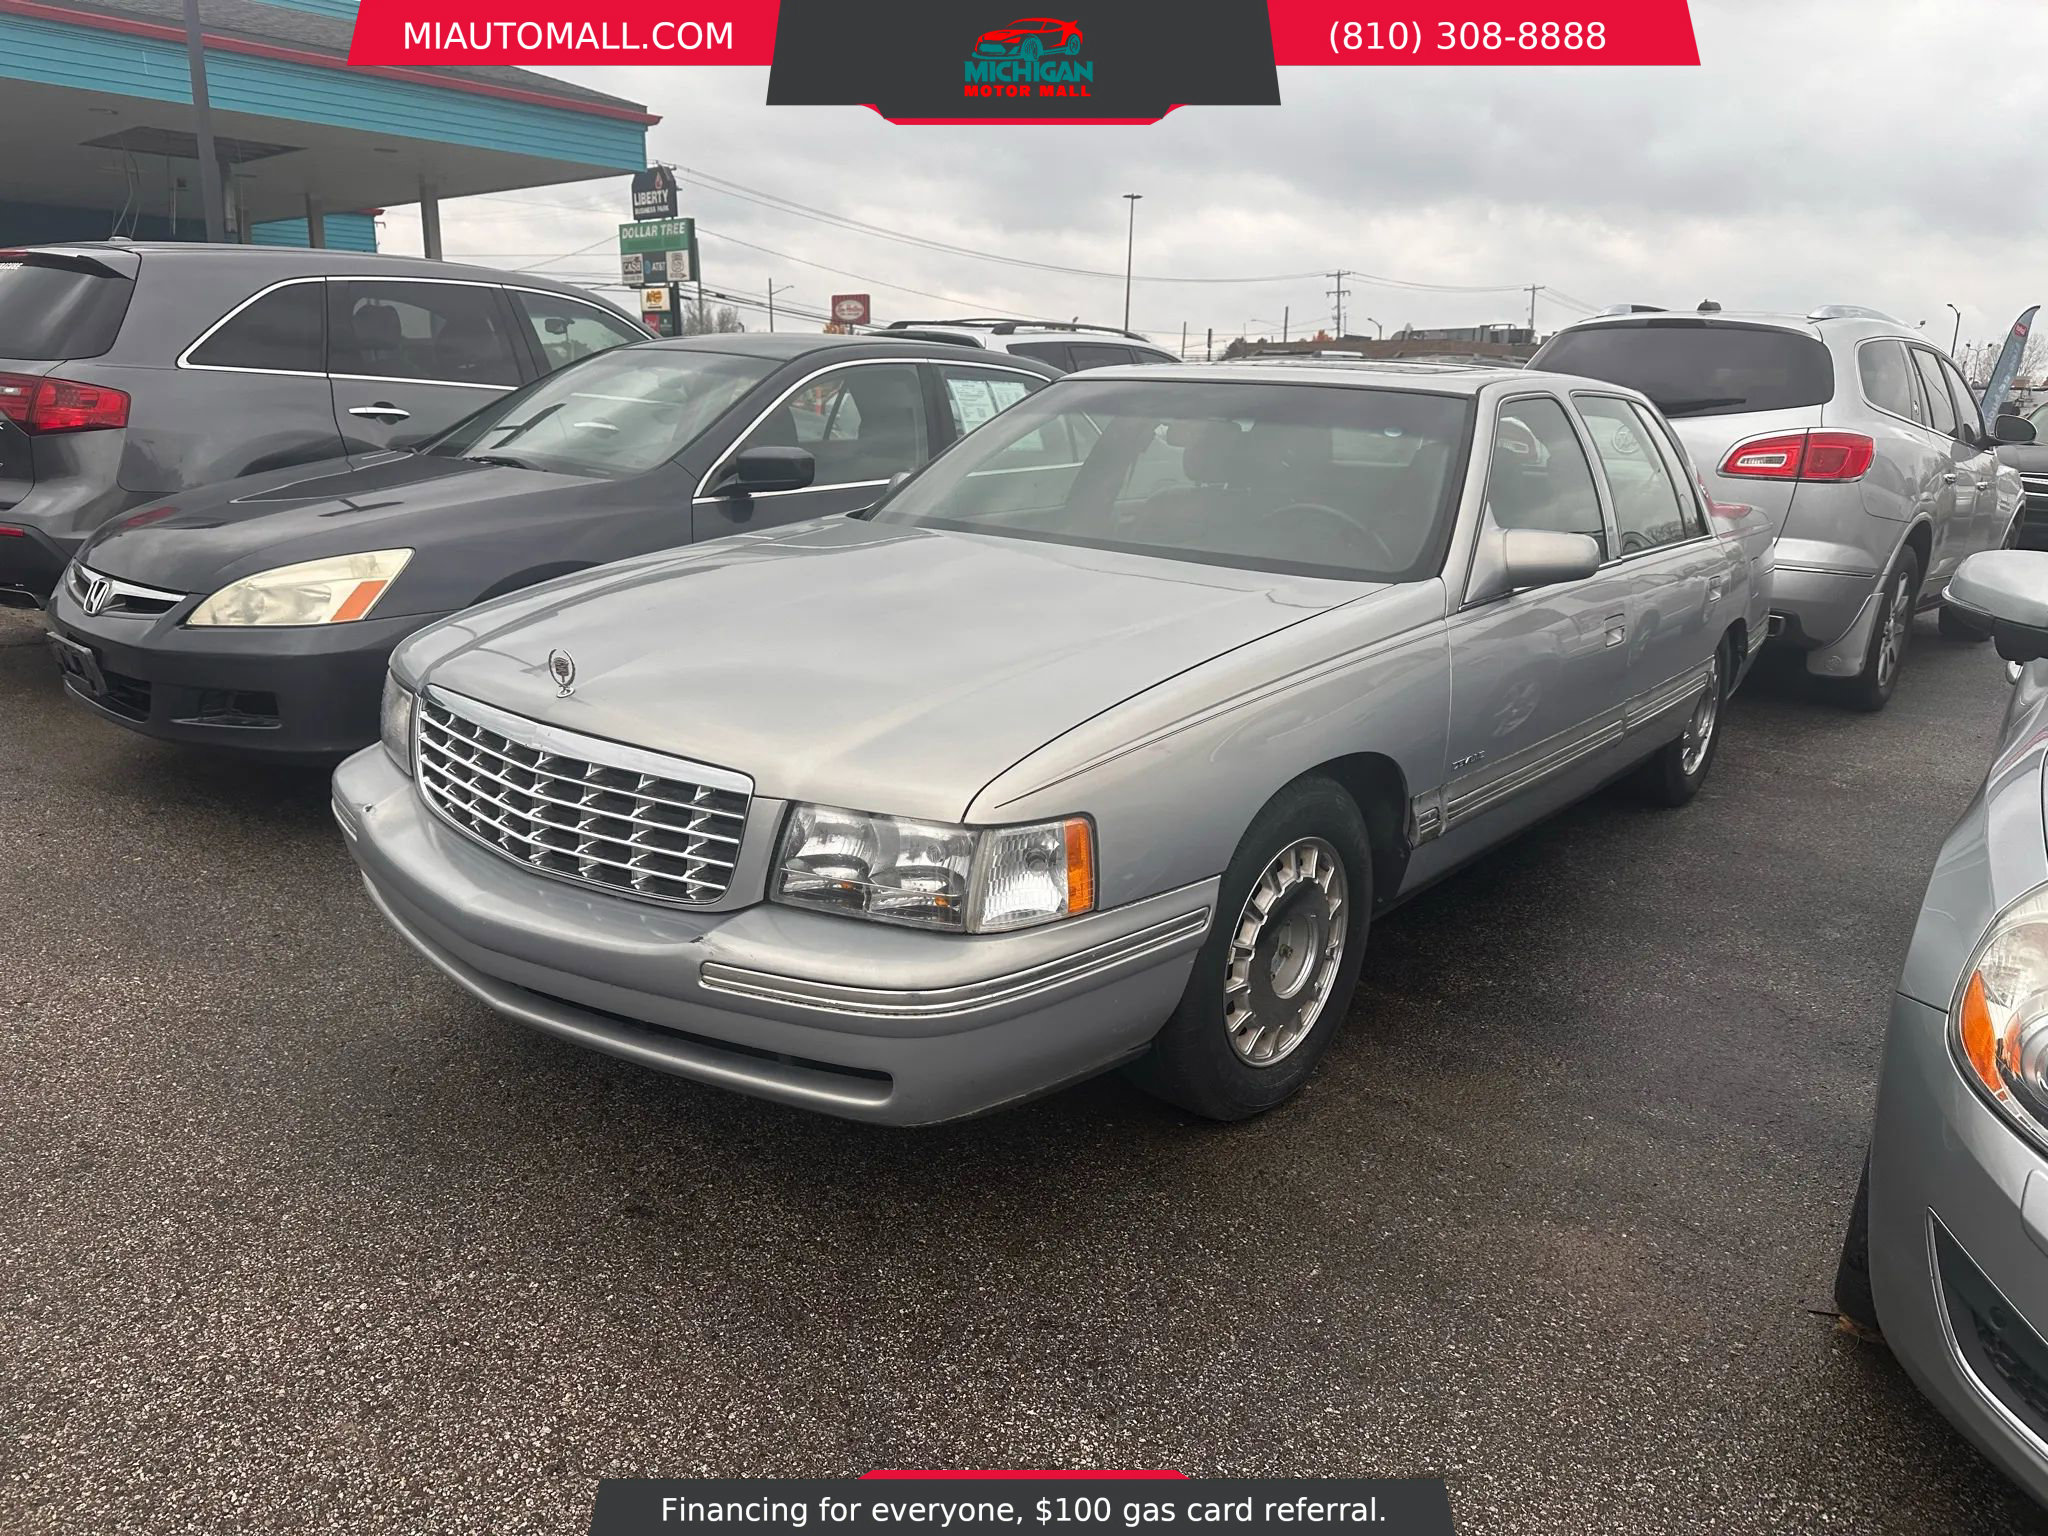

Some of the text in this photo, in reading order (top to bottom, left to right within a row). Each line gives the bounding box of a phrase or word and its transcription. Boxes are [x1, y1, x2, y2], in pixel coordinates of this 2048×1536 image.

[633, 189, 669, 206] LIBERTY
[622, 221, 686, 239] DOLLAR TREE
